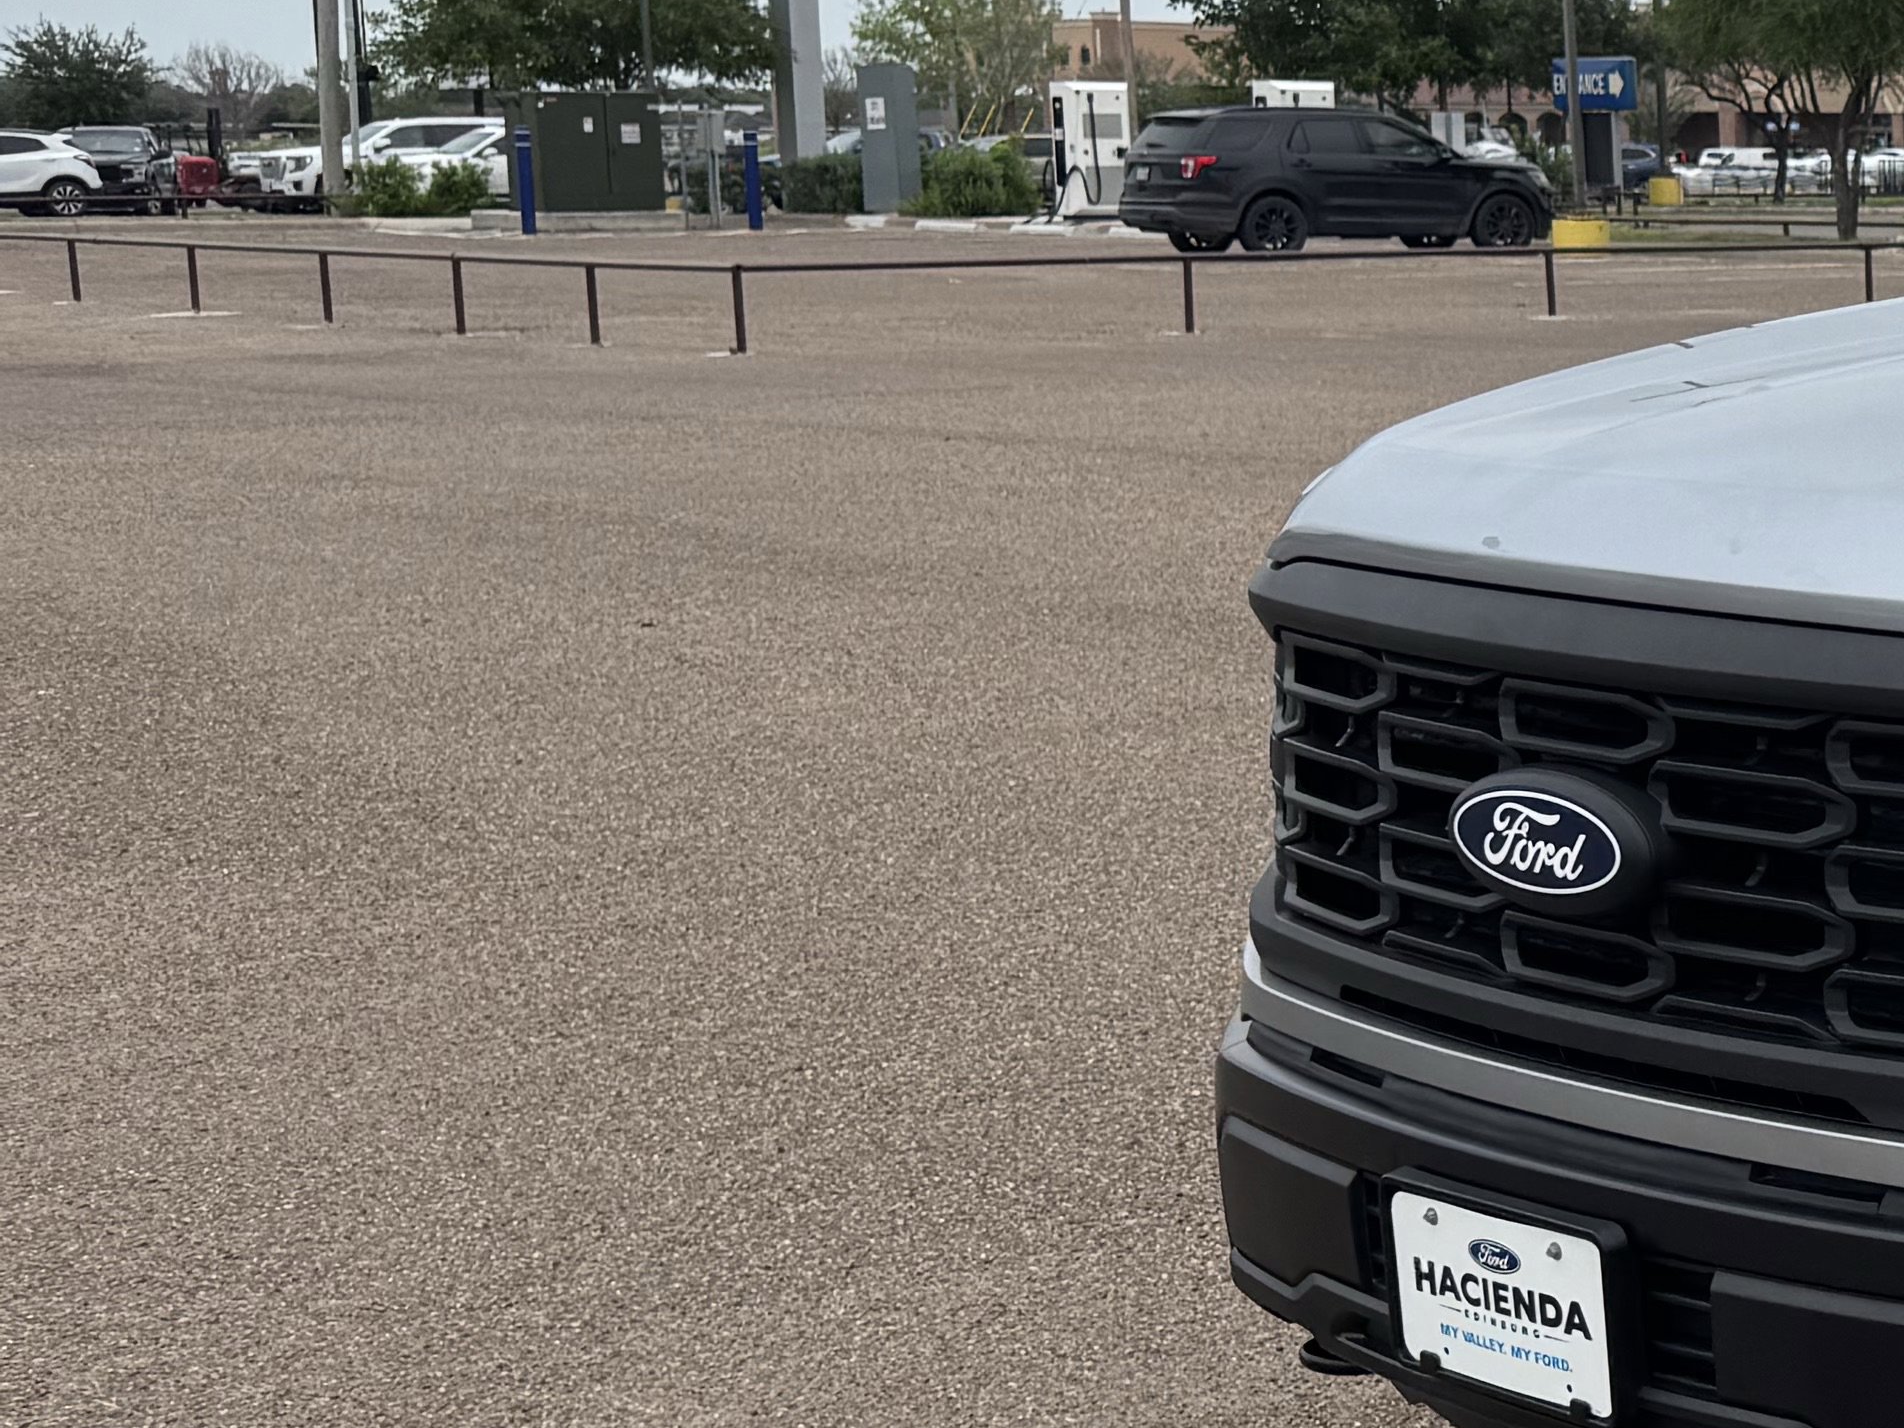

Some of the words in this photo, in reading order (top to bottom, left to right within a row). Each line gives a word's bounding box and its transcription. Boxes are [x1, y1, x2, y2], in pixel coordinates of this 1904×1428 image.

[1553, 73, 1606, 95] ENANCE
[1483, 802, 1587, 881] Ford
[1478, 1244, 1509, 1270] Ford
[1413, 1256, 1593, 1341] HACIENDA
[1464, 1309, 1541, 1338] EDINBURG
[1440, 1322, 1459, 1339] MY
[1462, 1329, 1507, 1355] VALLEY.
[1511, 1344, 1531, 1361] MY
[1534, 1351, 1573, 1373] FORD.
